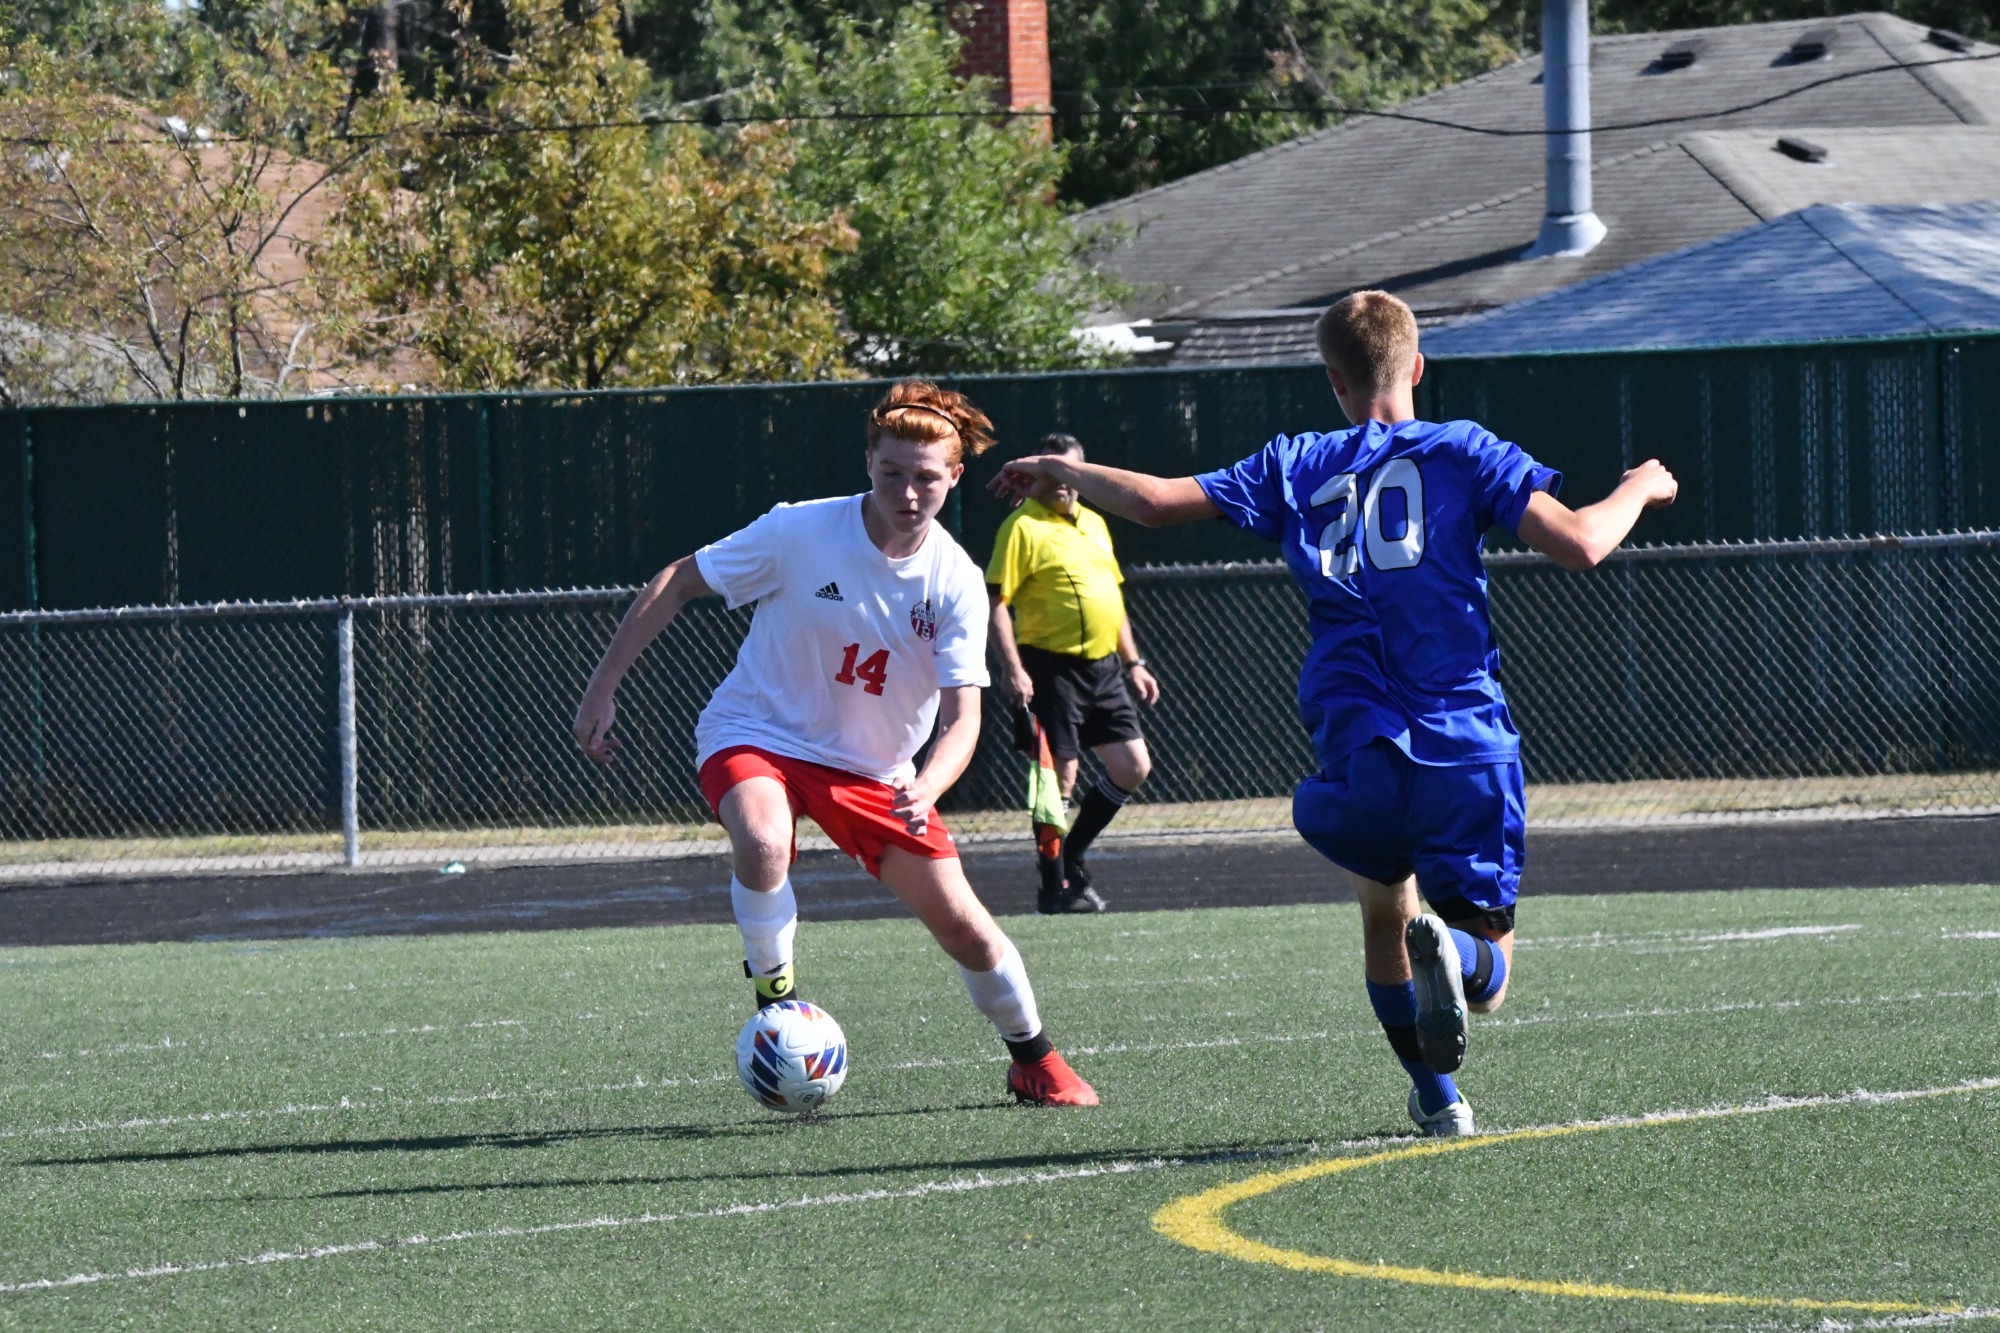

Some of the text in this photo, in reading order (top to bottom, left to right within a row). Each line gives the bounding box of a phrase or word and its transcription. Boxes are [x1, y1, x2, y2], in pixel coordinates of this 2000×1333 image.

[1310, 458, 1425, 581] 20
[815, 591, 844, 602] adidas
[834, 642, 890, 696] 14
[769, 975, 788, 995] C
